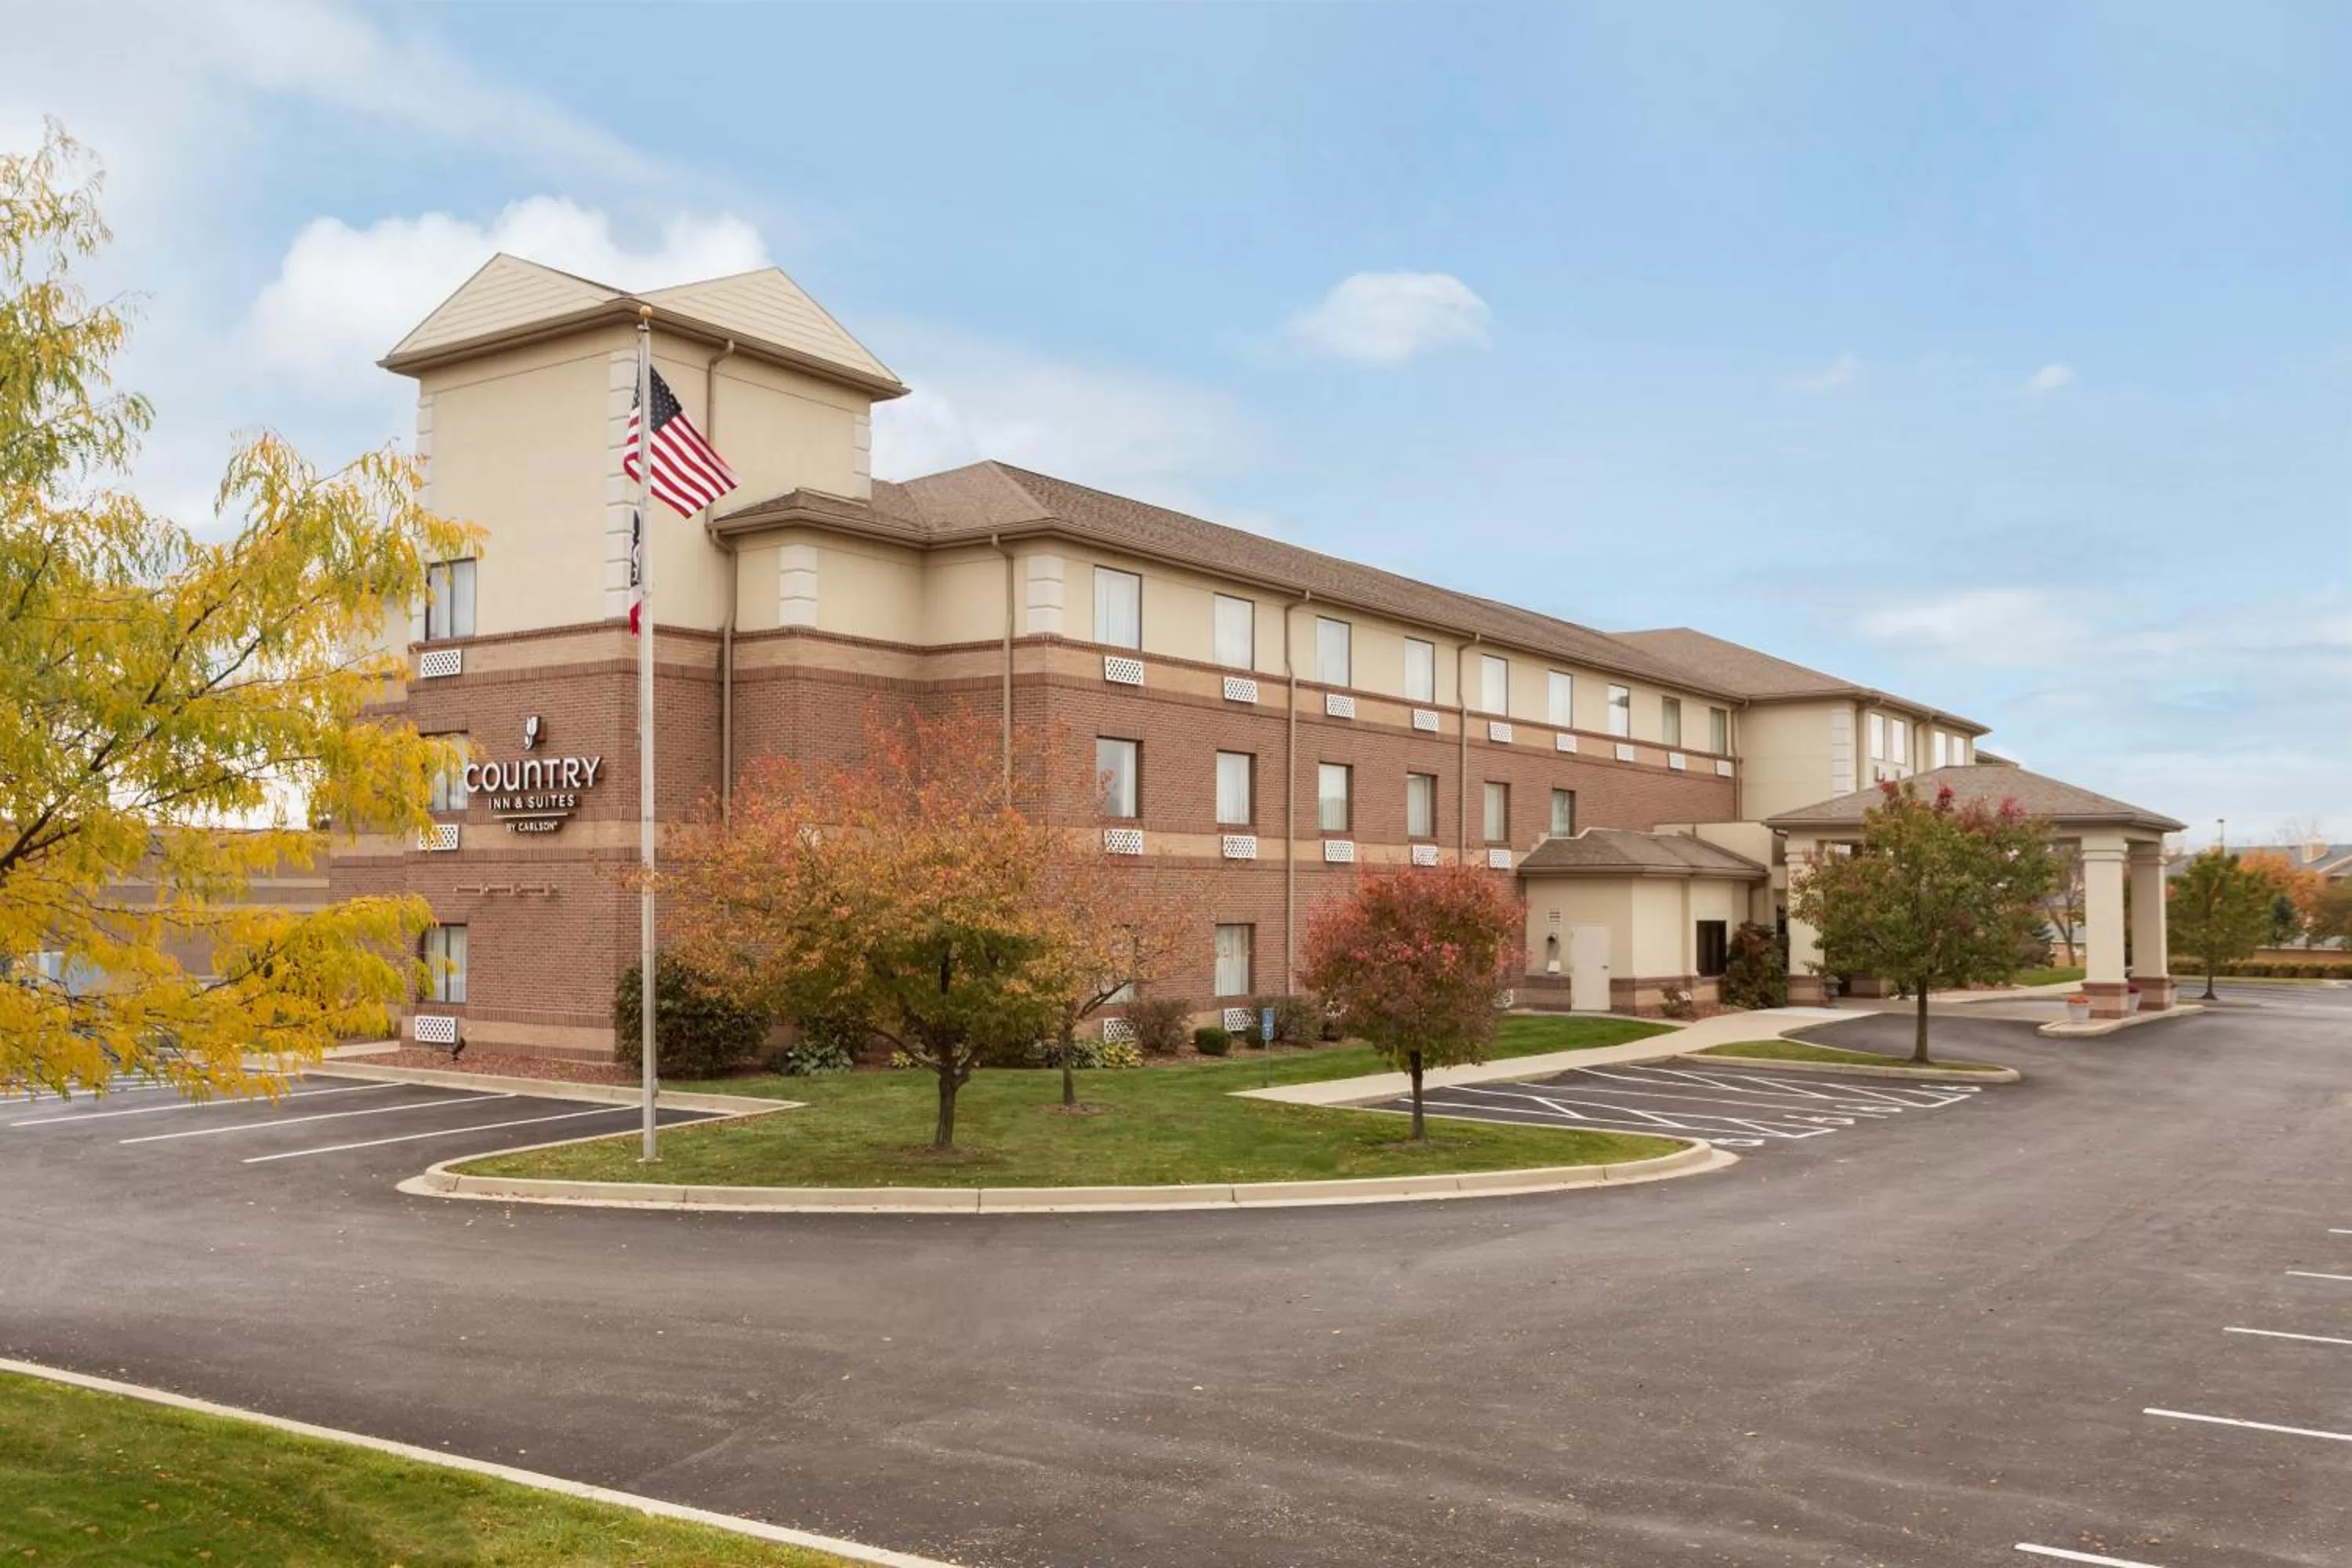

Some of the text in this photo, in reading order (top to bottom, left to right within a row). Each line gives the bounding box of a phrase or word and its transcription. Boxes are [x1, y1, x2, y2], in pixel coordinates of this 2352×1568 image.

[488, 794, 575, 809] INN & SUITES
[506, 823, 516, 832] BY
